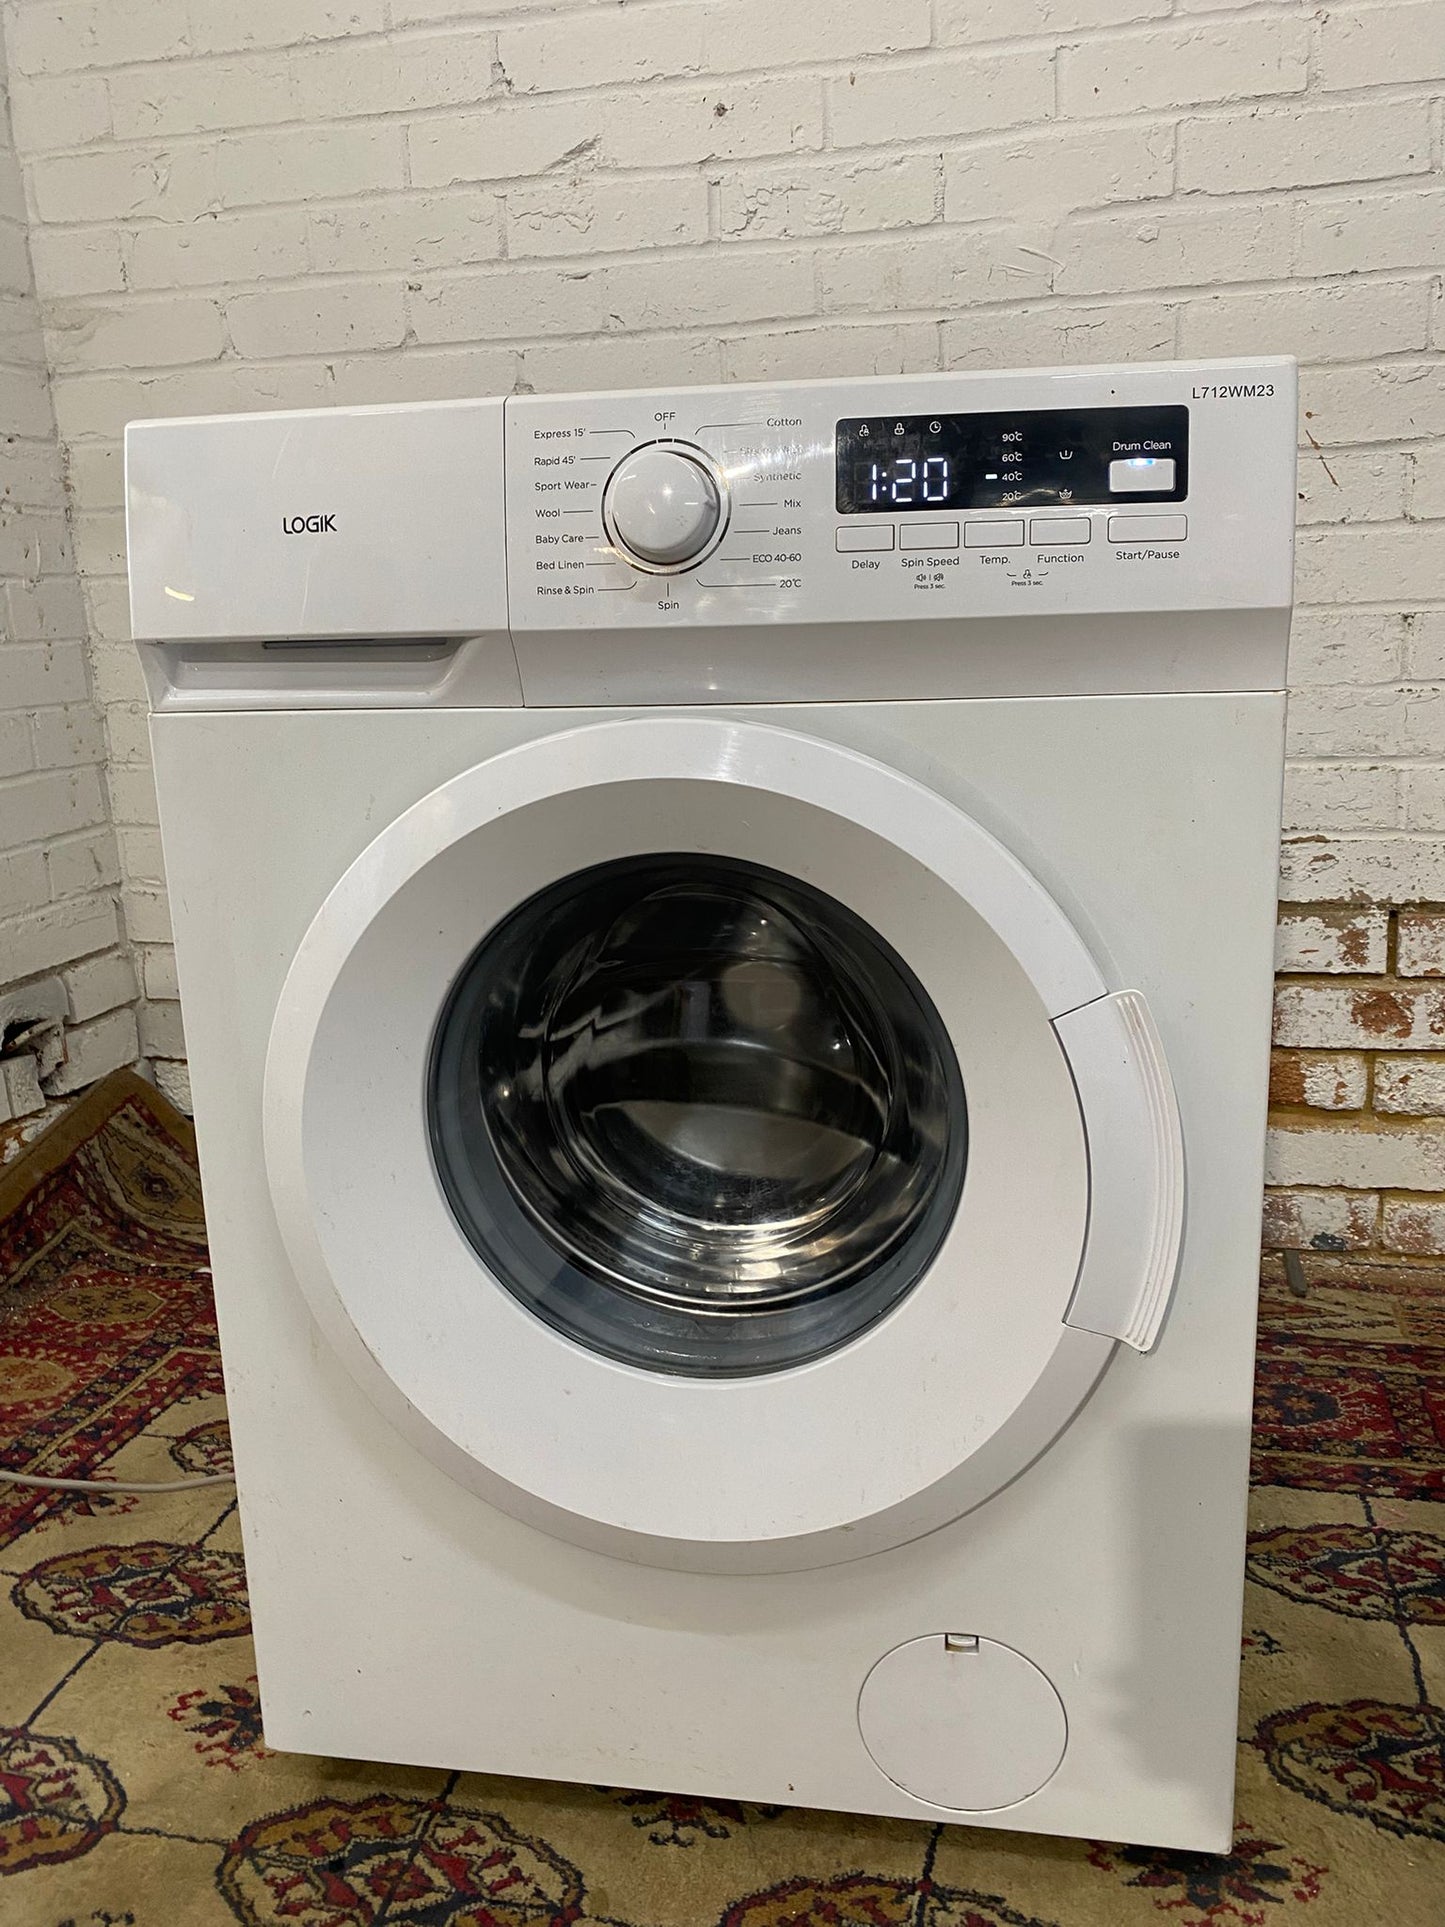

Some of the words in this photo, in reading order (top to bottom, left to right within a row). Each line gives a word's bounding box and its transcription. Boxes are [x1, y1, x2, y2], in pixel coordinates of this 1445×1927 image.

[1192, 385, 1275, 399] L712WM23
[654, 412, 676, 422] OFF
[766, 418, 801, 427] Cotton
[534, 430, 571, 440] Express
[574, 428, 586, 437] 15'
[1112, 441, 1141, 451] Drum
[1143, 440, 1171, 450] Clean
[534, 457, 560, 467] Rapid
[562, 456, 576, 465] 45'
[872, 457, 948, 502] 1:20
[535, 482, 561, 492] Sport
[564, 481, 589, 489] Wear
[784, 500, 801, 508] Mix
[535, 509, 560, 518] Wool
[283, 514, 338, 534] LOGIK
[772, 527, 801, 535] Jeans
[535, 535, 560, 545] Baby
[562, 534, 584, 543] Care
[752, 554, 772, 563] ECO
[774, 553, 801, 562] 40-60
[980, 555, 1011, 565] Temp.
[1037, 553, 1085, 563] Function
[1115, 550, 1180, 561] Start/Pause
[536, 561, 555, 570] Bed
[558, 560, 584, 569] Linen
[851, 560, 880, 570] Delay
[901, 558, 924, 569] Spin
[926, 556, 960, 567] Speed
[537, 586, 563, 595] Rinse
[564, 586, 571, 595] &
[573, 586, 594, 596] Spin
[658, 601, 680, 611] Spin
